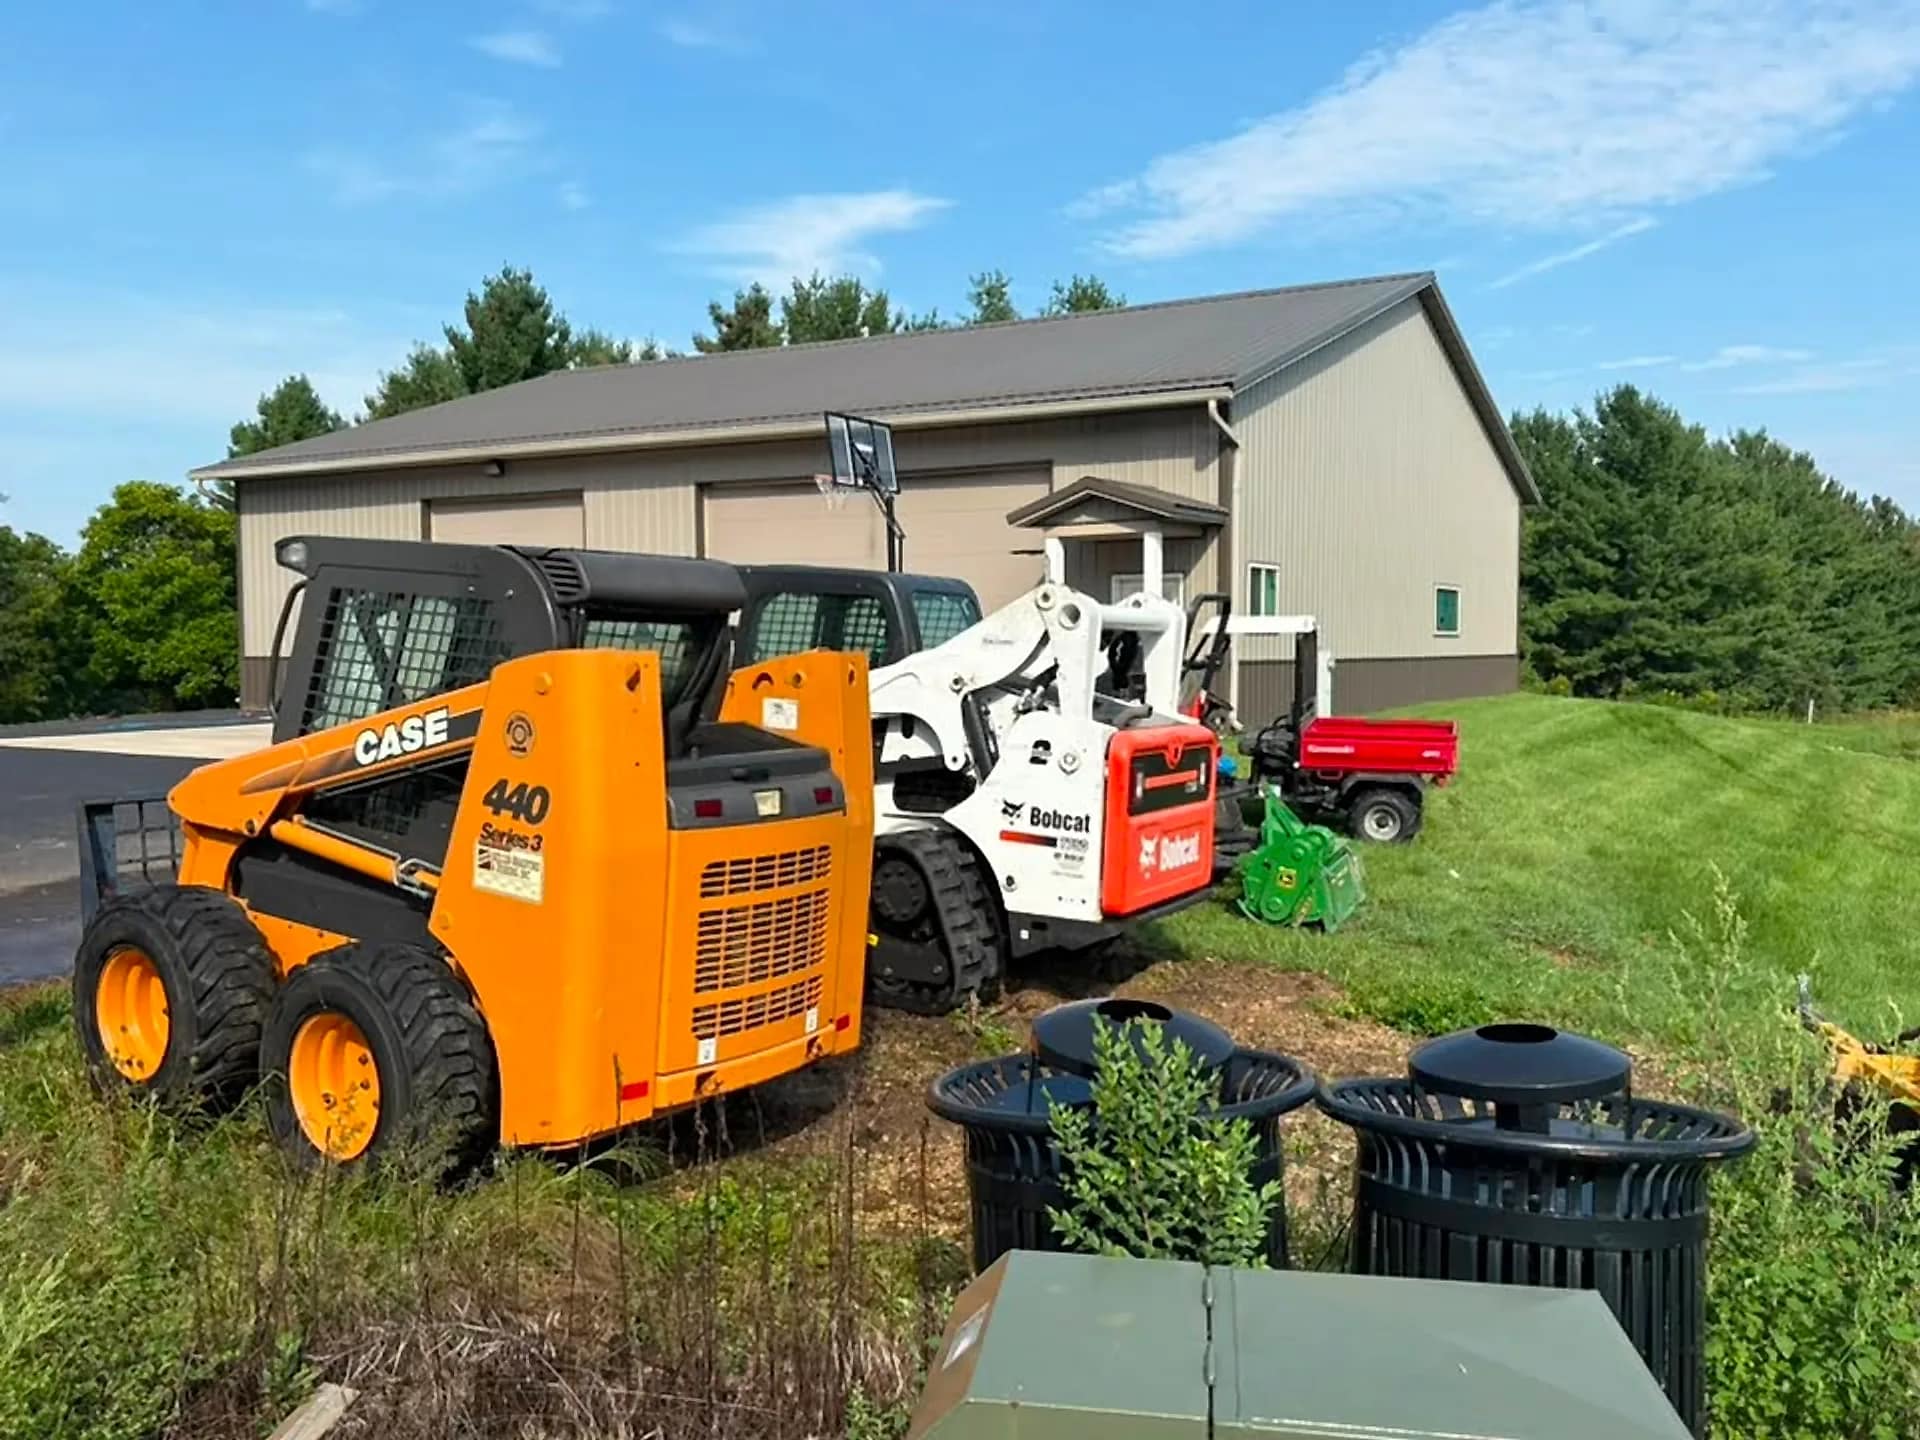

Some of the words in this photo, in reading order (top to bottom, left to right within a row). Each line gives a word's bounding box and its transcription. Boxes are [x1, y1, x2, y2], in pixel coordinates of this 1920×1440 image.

[355, 706, 450, 766] CASE
[482, 779, 550, 824] 440
[1030, 806, 1090, 833] Bobcat
[480, 822, 529, 849] Series
[530, 834, 543, 851] 3
